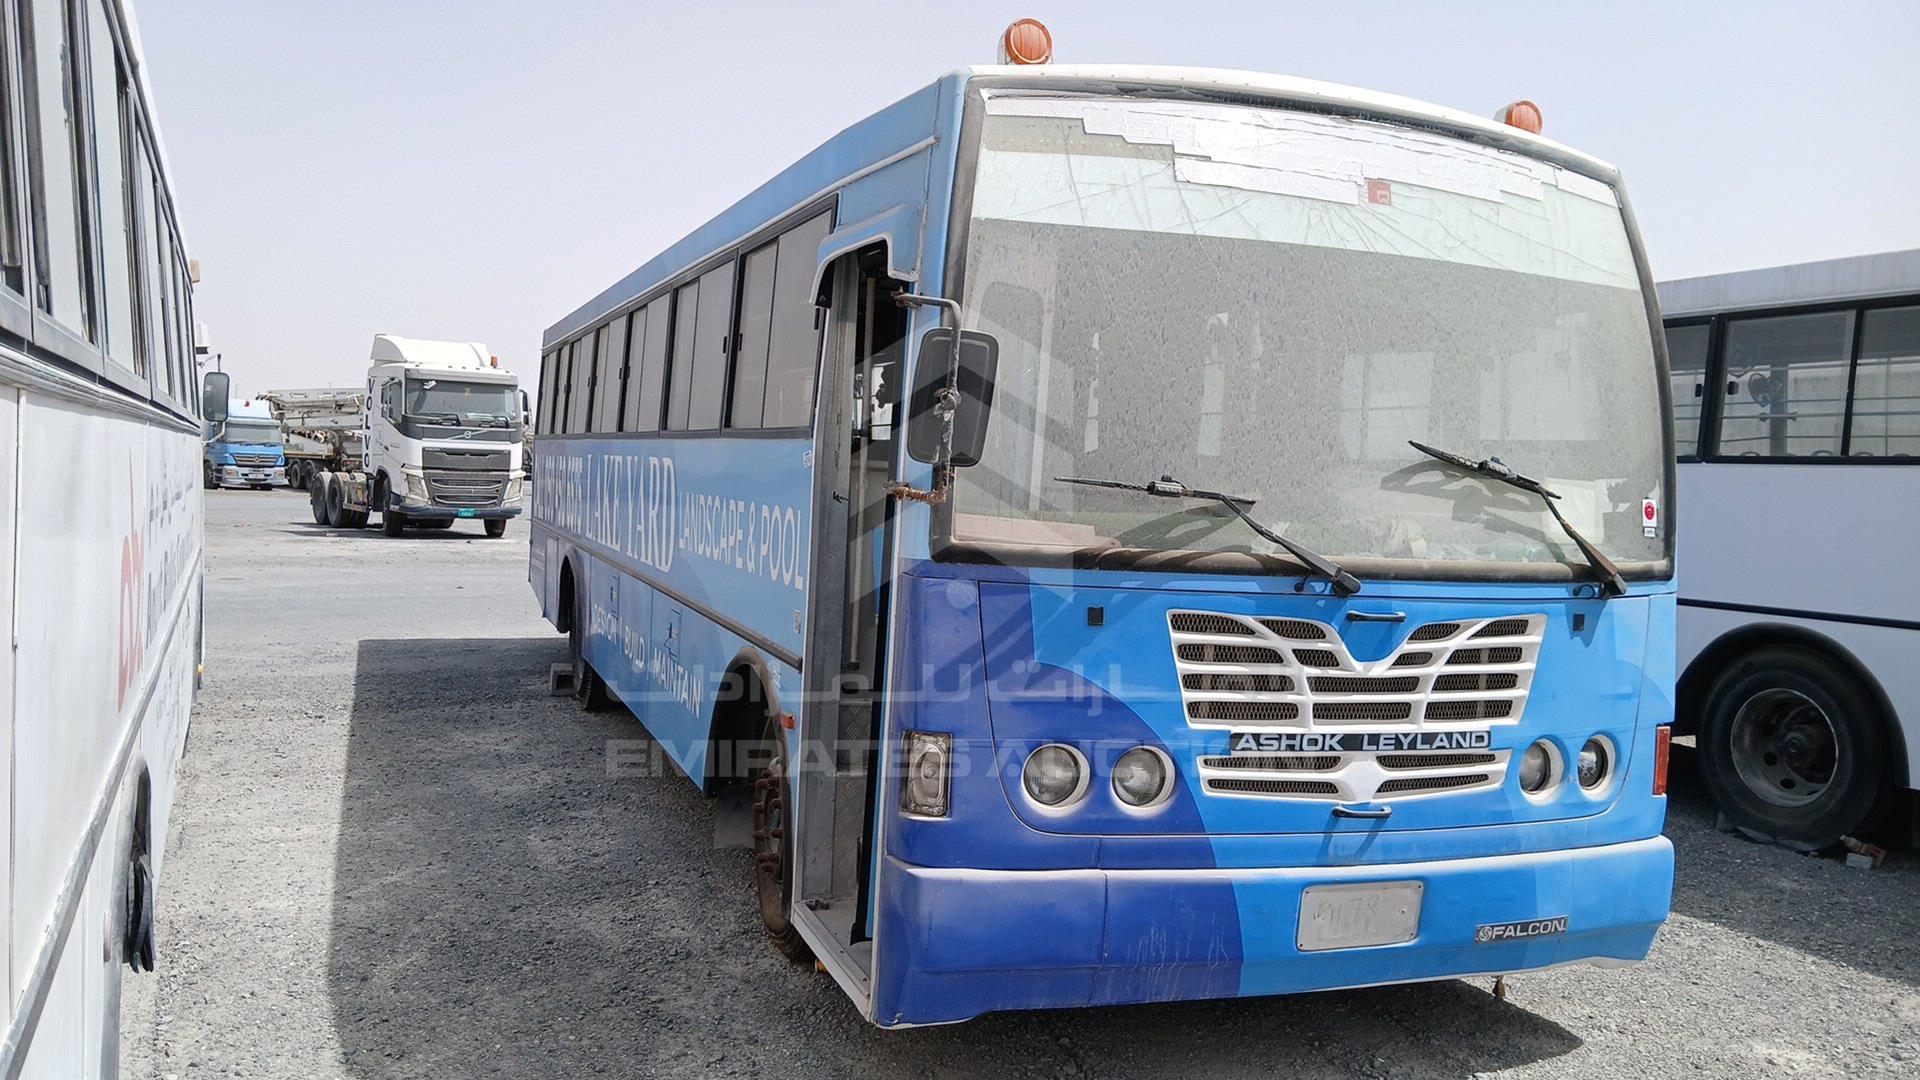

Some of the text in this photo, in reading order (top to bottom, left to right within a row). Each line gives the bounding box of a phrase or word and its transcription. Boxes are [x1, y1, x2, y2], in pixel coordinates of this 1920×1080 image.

[363, 378, 376, 468] VOLVO
[585, 454, 622, 552] LAKE
[626, 455, 676, 573] YARD
[679, 491, 744, 570] LANDSCAPE
[747, 501, 756, 575] &
[759, 503, 803, 590] POOL
[624, 625, 645, 669] BUILD
[653, 646, 701, 719] MAINTAIN
[1235, 730, 1489, 751] ASHOK LEYLAND
[1492, 919, 1566, 940] FALCON
